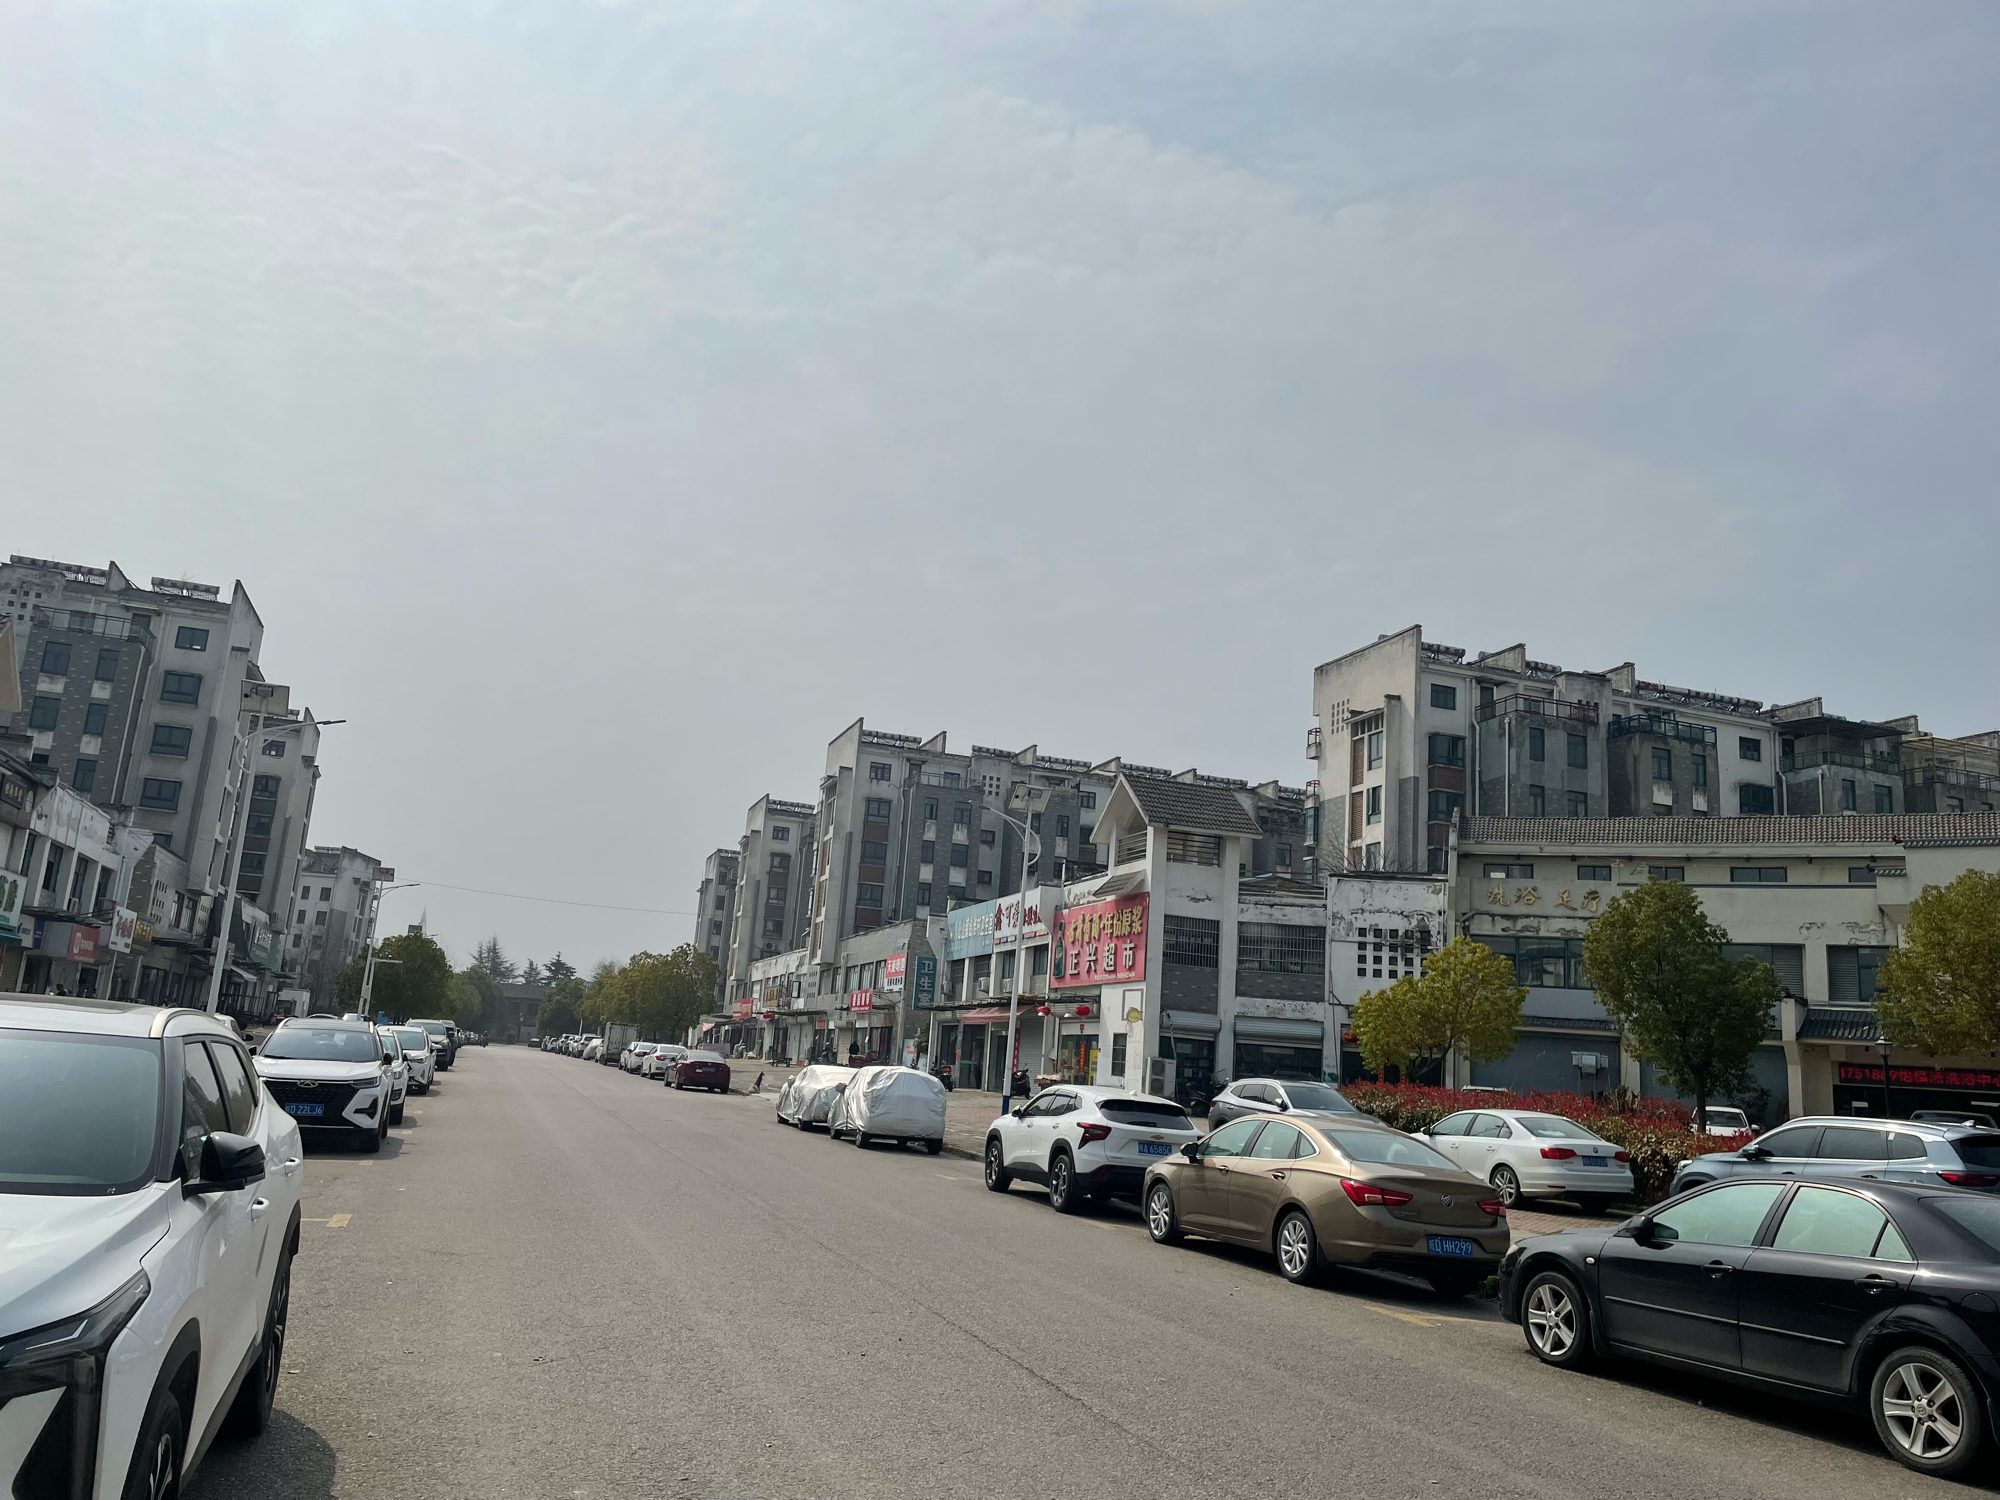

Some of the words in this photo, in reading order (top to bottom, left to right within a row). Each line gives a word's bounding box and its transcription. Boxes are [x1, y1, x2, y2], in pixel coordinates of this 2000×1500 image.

[1487, 883, 1541, 907] 洗浴
[1554, 885, 1601, 913] 足疗
[1067, 938, 1135, 975] 正兴超市
[917, 960, 935, 1008] 卫生室
